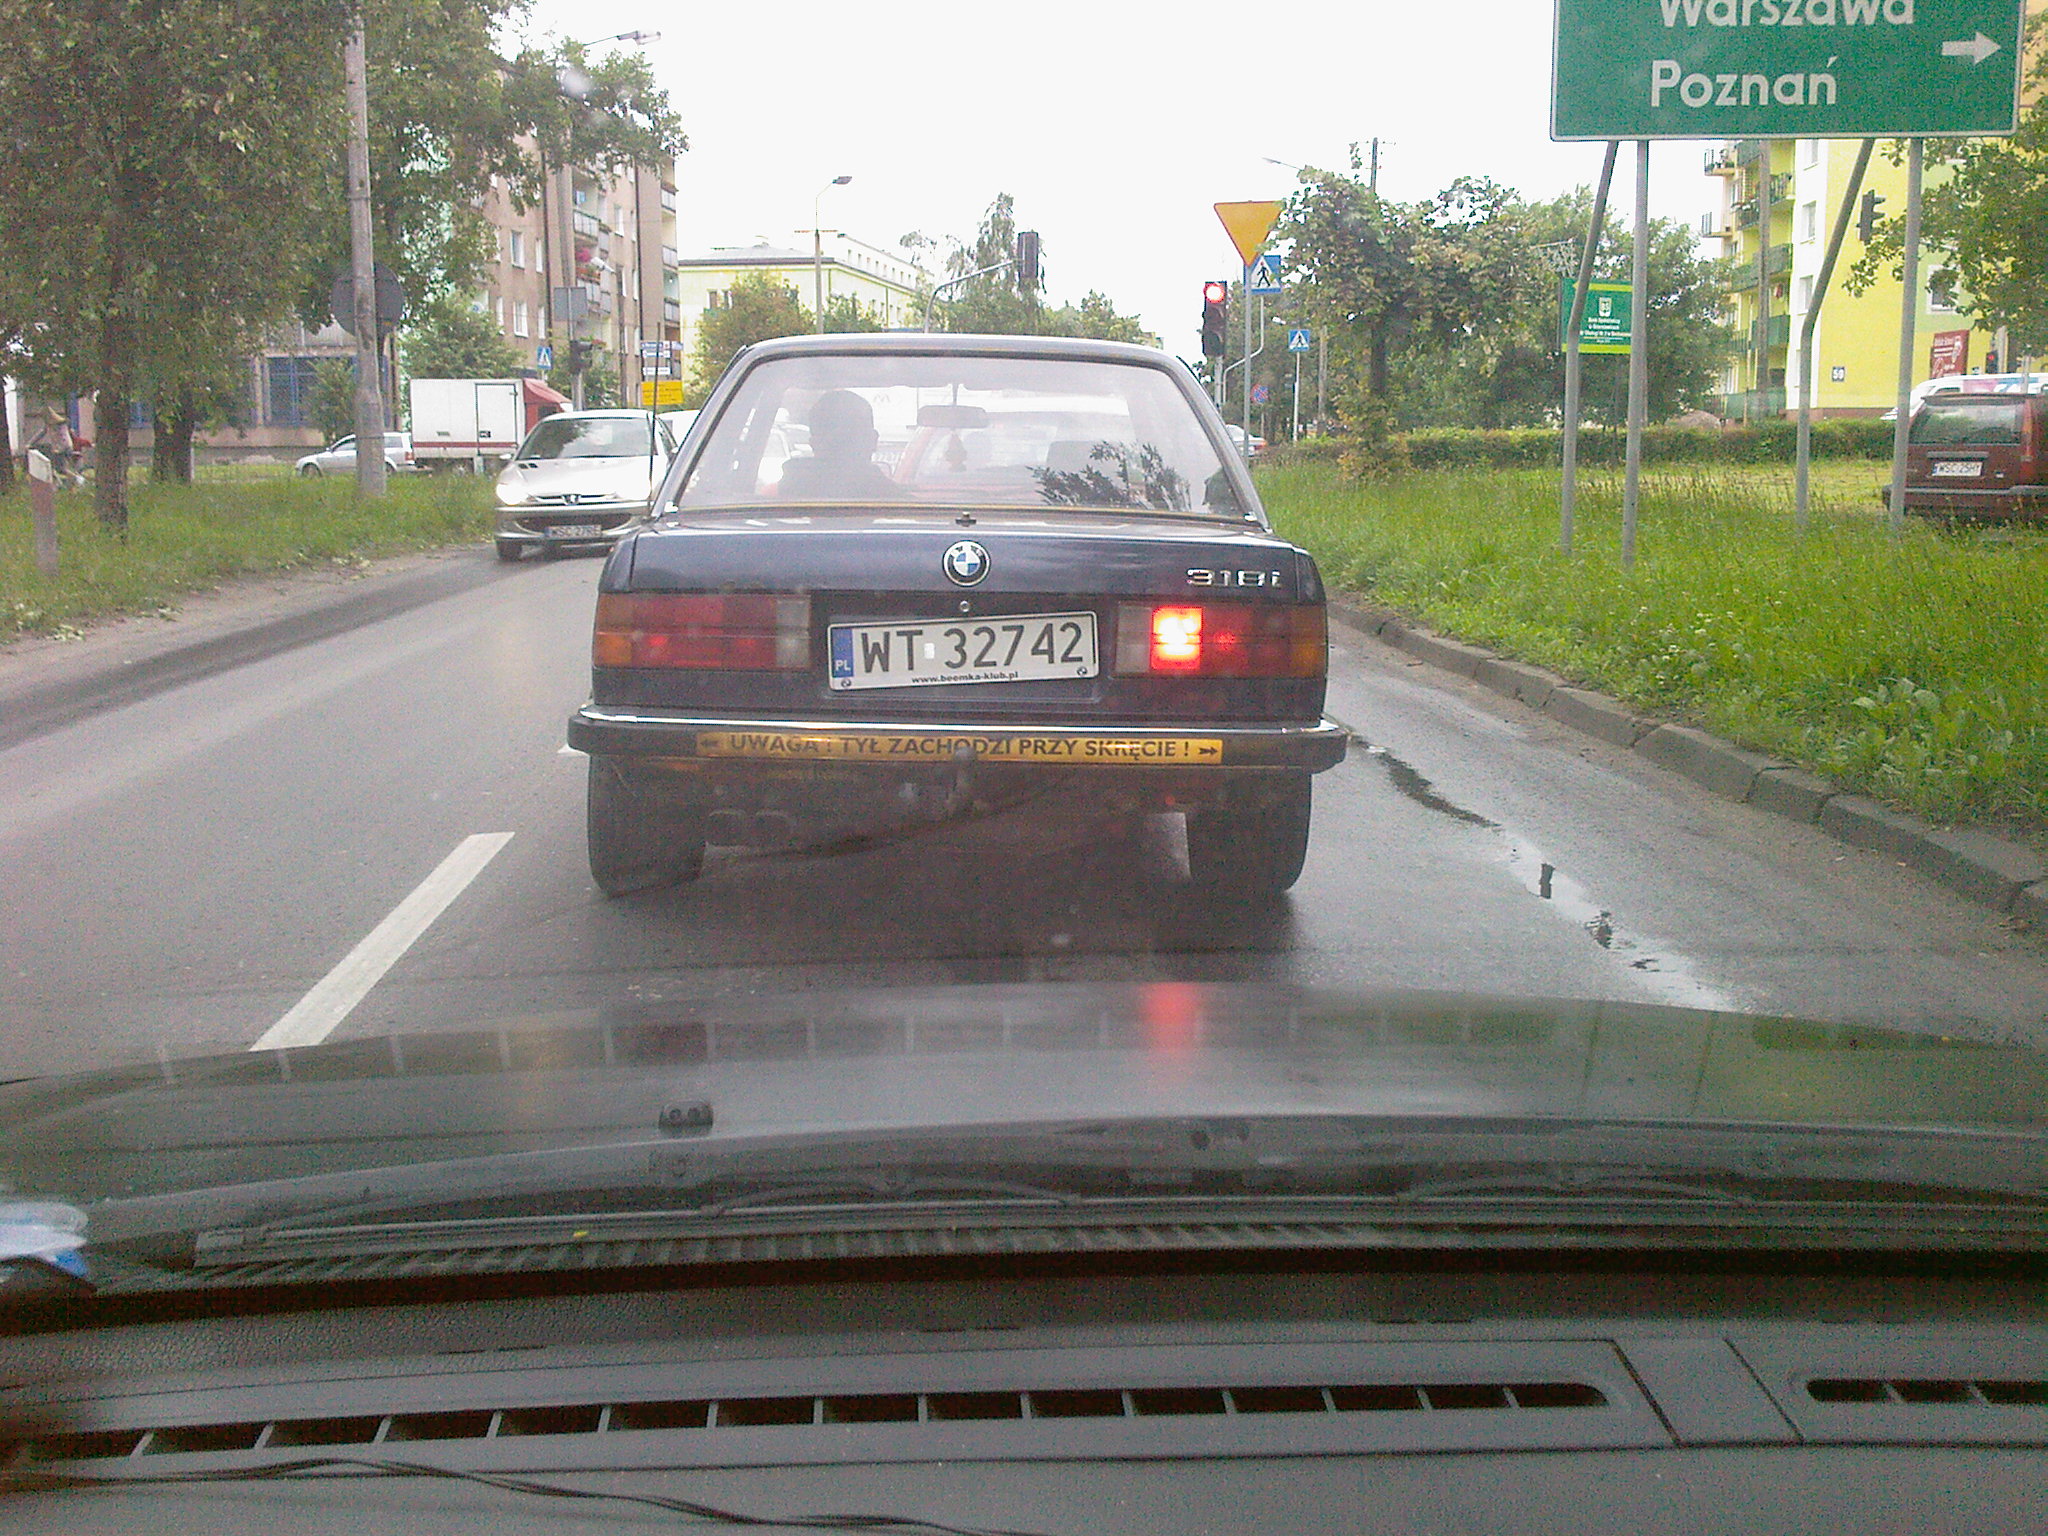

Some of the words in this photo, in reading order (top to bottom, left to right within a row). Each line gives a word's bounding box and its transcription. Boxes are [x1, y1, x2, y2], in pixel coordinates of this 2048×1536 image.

[1660, 0, 1914, 27] Warszawa
[1652, 56, 1838, 107] Poznań
[1186, 568, 1281, 586] 318i
[860, 629, 924, 673] WT
[943, 621, 1084, 670] 32742
[835, 660, 850, 671] PL
[911, 671, 1019, 684] www.beemka-klub.pl
[840, 738, 882, 753] TYŁ
[888, 738, 1010, 757] ZACHODZI
[1019, 739, 1077, 756] PRZY
[1085, 740, 1177, 760] SKRĘCIE
